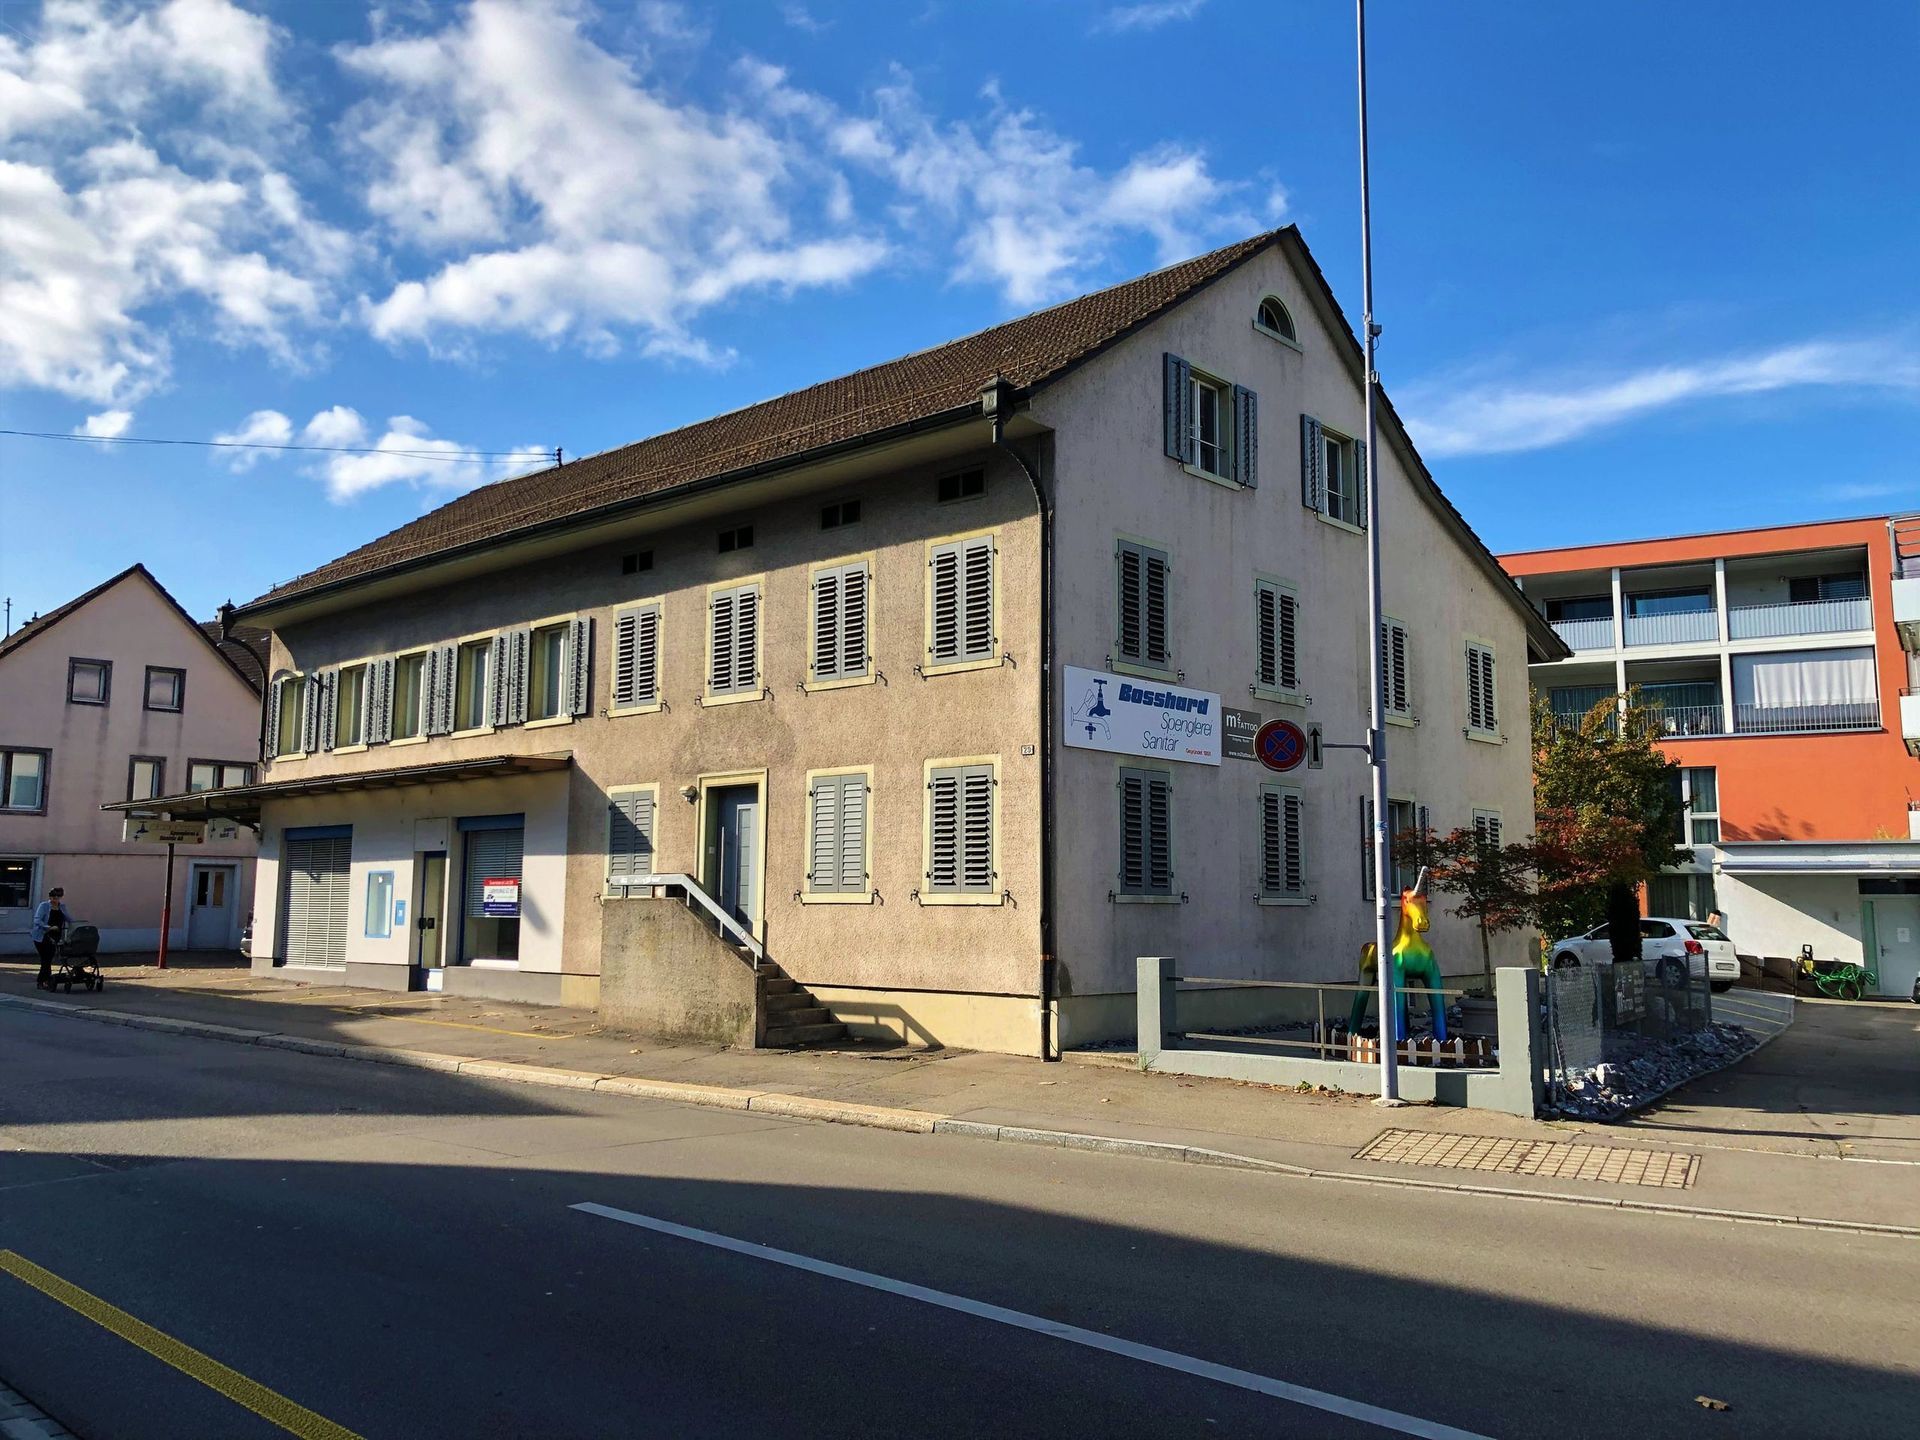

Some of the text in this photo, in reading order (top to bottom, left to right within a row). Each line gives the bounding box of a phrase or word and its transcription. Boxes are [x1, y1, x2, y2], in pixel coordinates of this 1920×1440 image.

[1118, 683, 1209, 715] Bosshard
[1160, 711, 1213, 738] Spenglerei
[1237, 721, 1258, 731] TATTOO
[1142, 730, 1180, 752] Sanitär
